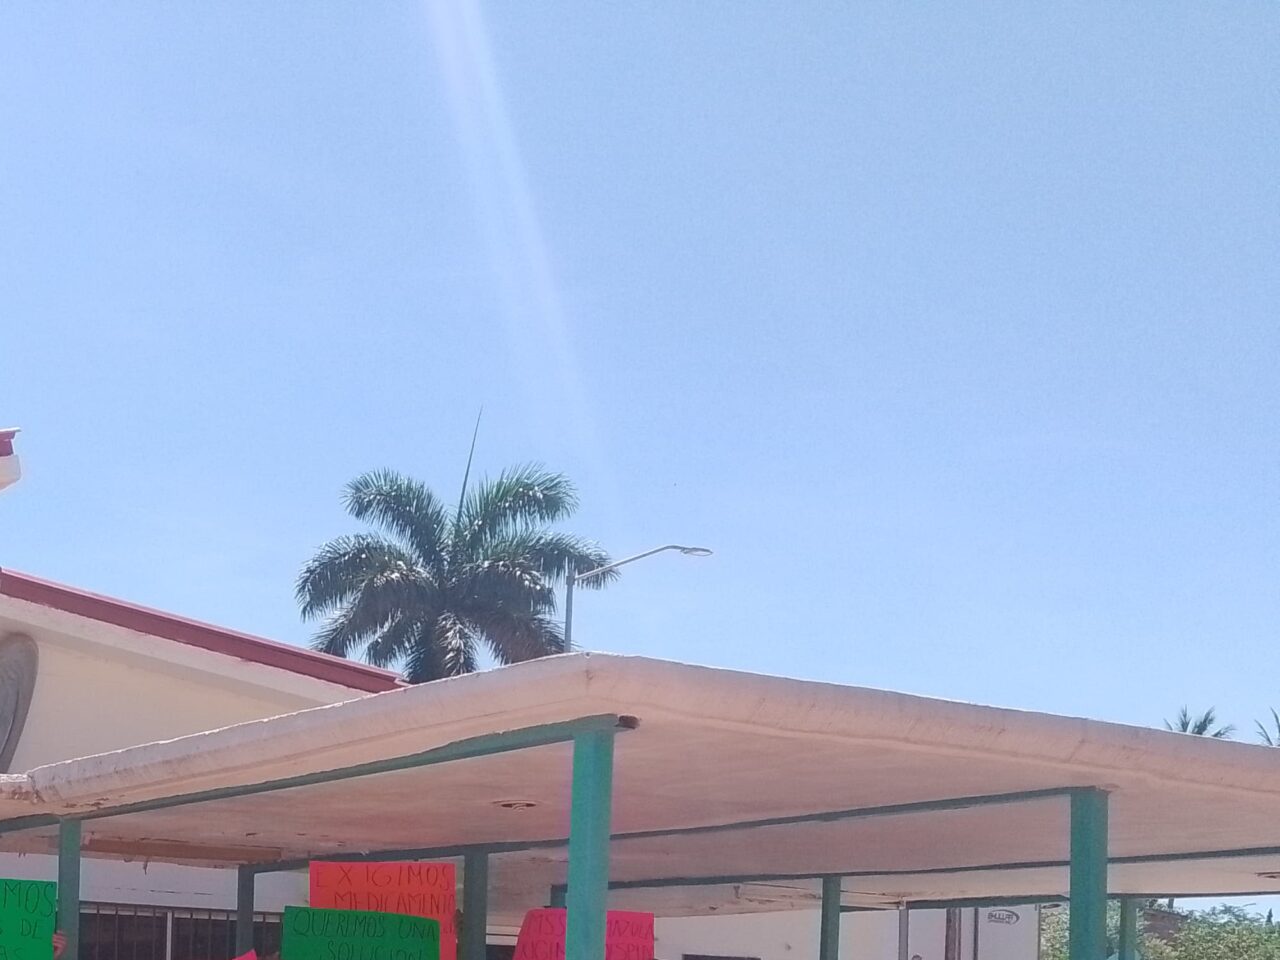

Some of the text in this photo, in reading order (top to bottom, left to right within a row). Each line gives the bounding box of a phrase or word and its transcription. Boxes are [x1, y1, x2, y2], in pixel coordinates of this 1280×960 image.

[316, 864, 451, 891] EXIGIMOS
[20, 918, 43, 939] DE
[398, 919, 436, 942] UNA
